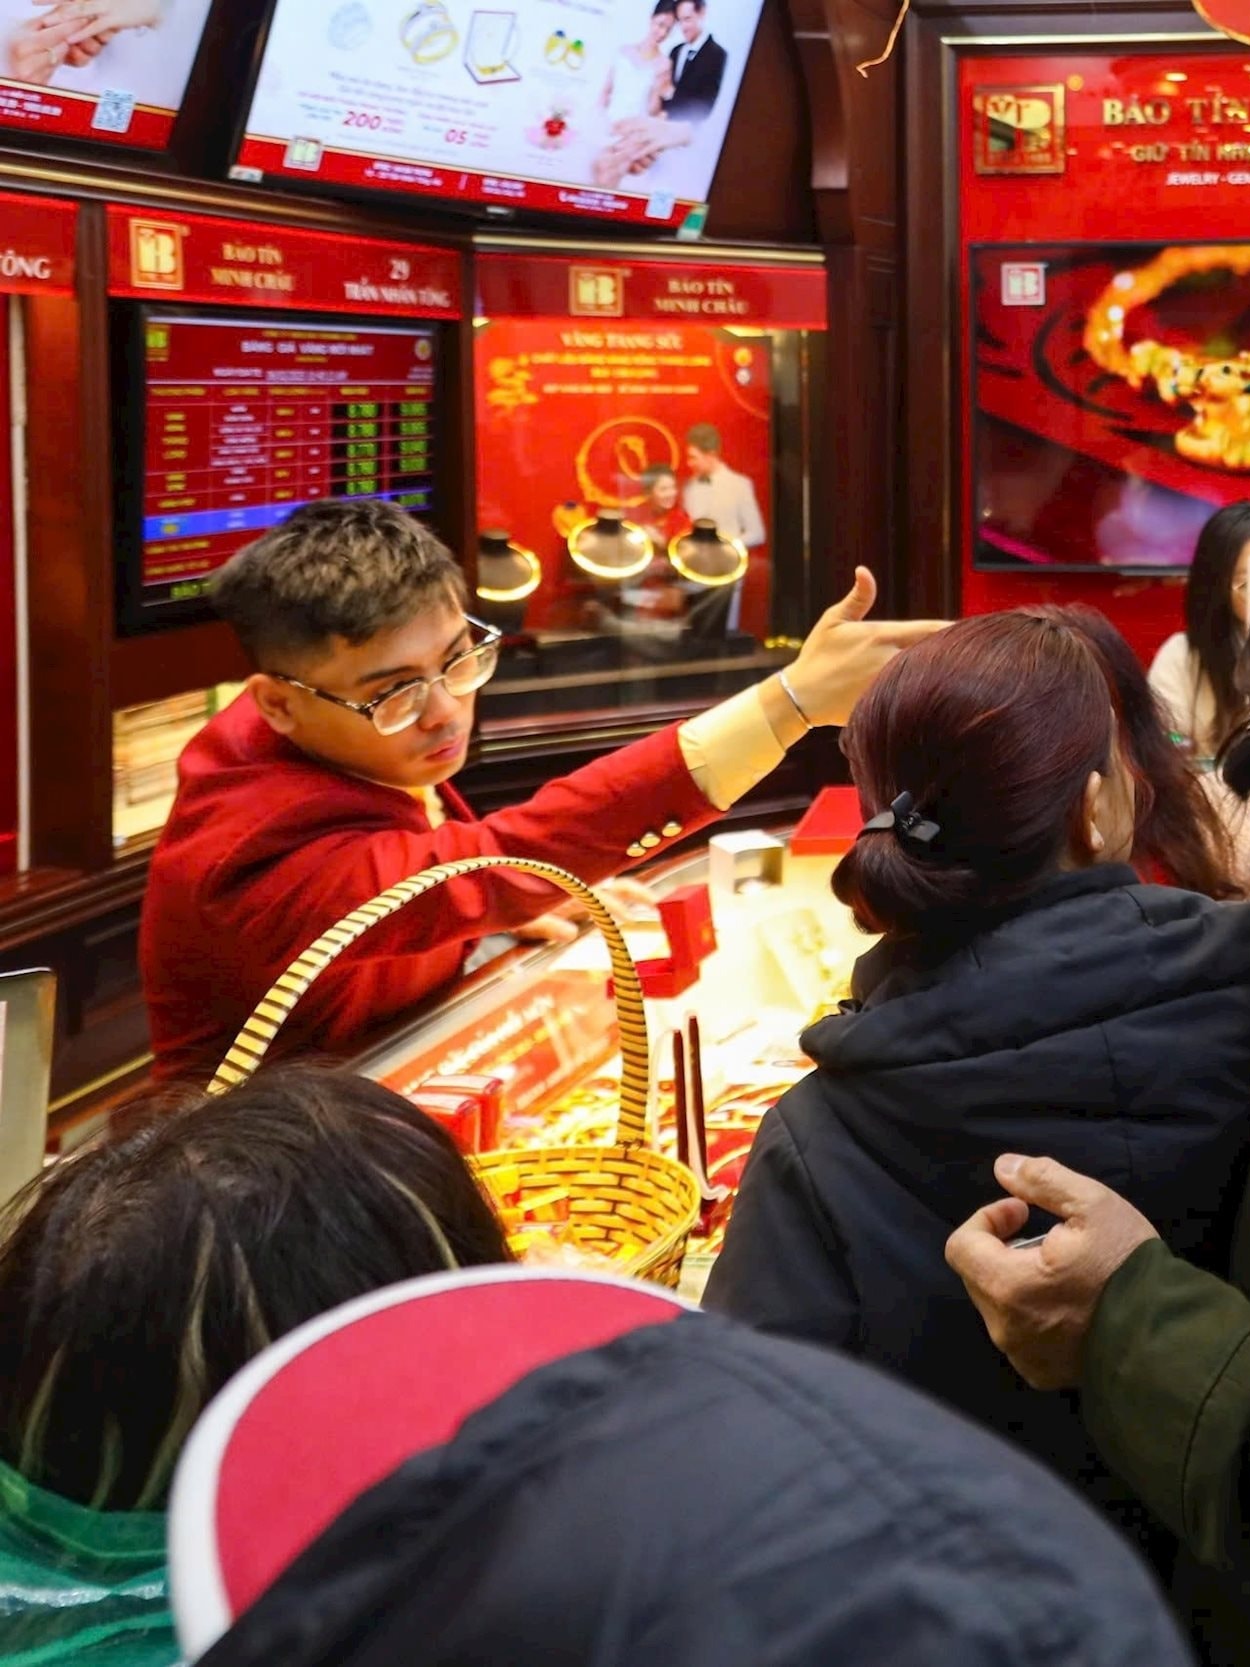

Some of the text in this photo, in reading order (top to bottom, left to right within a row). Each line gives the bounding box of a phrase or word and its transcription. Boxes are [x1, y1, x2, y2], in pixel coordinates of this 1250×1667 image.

[342, 109, 383, 131] 200
[444, 128, 468, 145] 05
[1166, 171, 1219, 186] JEWELRY
[389, 258, 411, 280] 29
